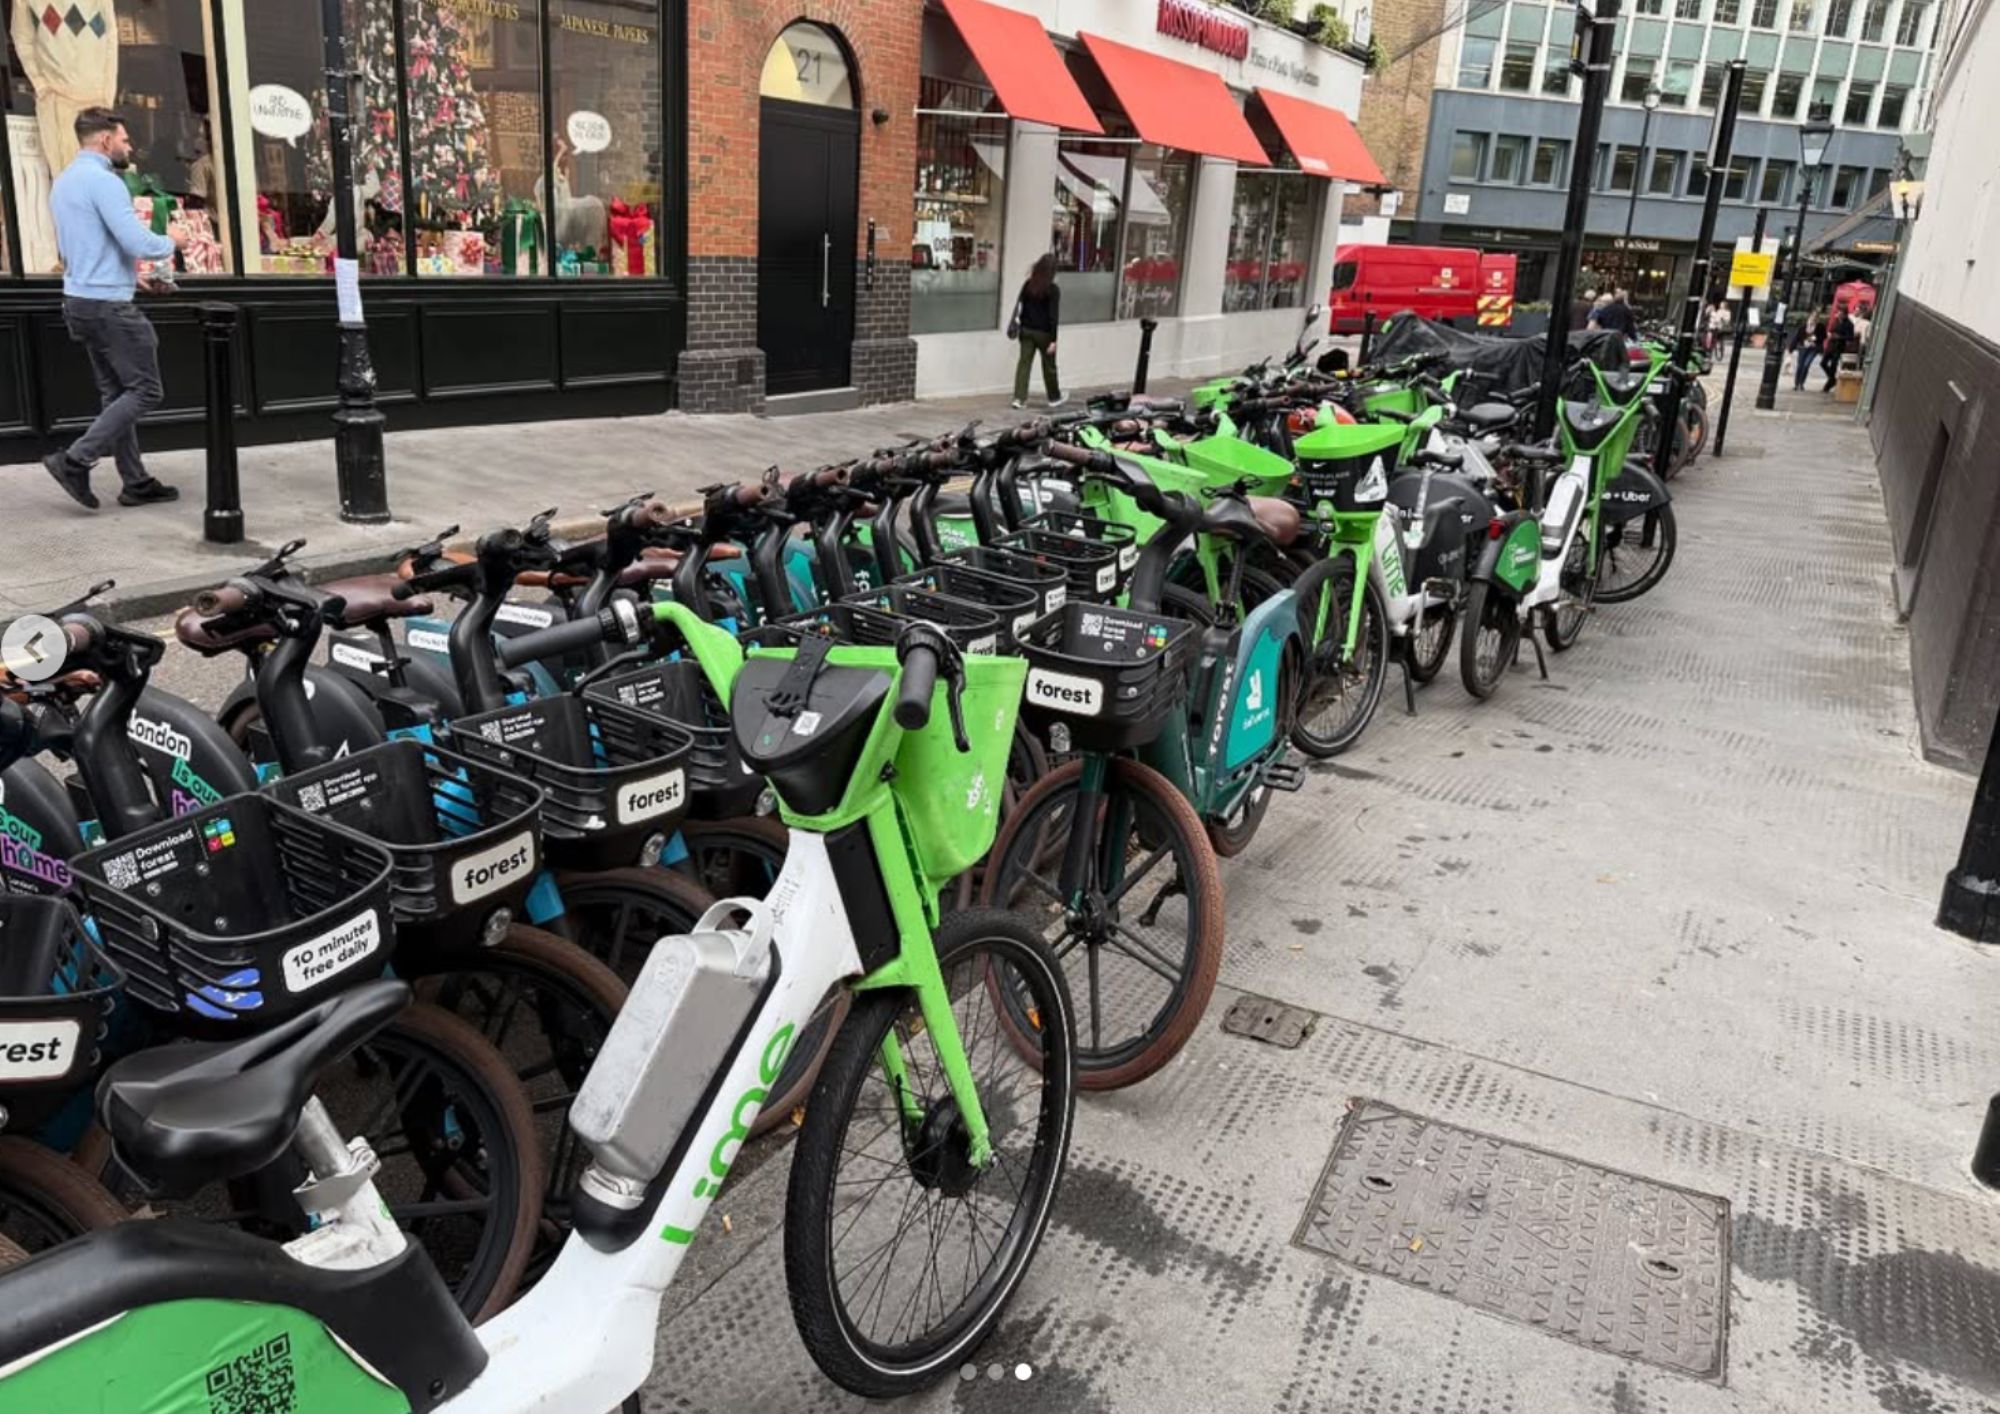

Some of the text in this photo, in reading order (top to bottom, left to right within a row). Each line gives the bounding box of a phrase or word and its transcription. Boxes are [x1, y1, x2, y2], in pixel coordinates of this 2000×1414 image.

[560, 13, 649, 44] JAPANESE PAPERS
[797, 48, 822, 85] 21
[1621, 490, 1651, 502] Uber
[1035, 679, 1092, 705] forest
[175, 760, 190, 784] is
[627, 782, 679, 812] forest
[135, 828, 194, 860] Download
[464, 846, 528, 890] forest
[292, 919, 373, 969] 10 minutes
[302, 937, 369, 981] free daily
